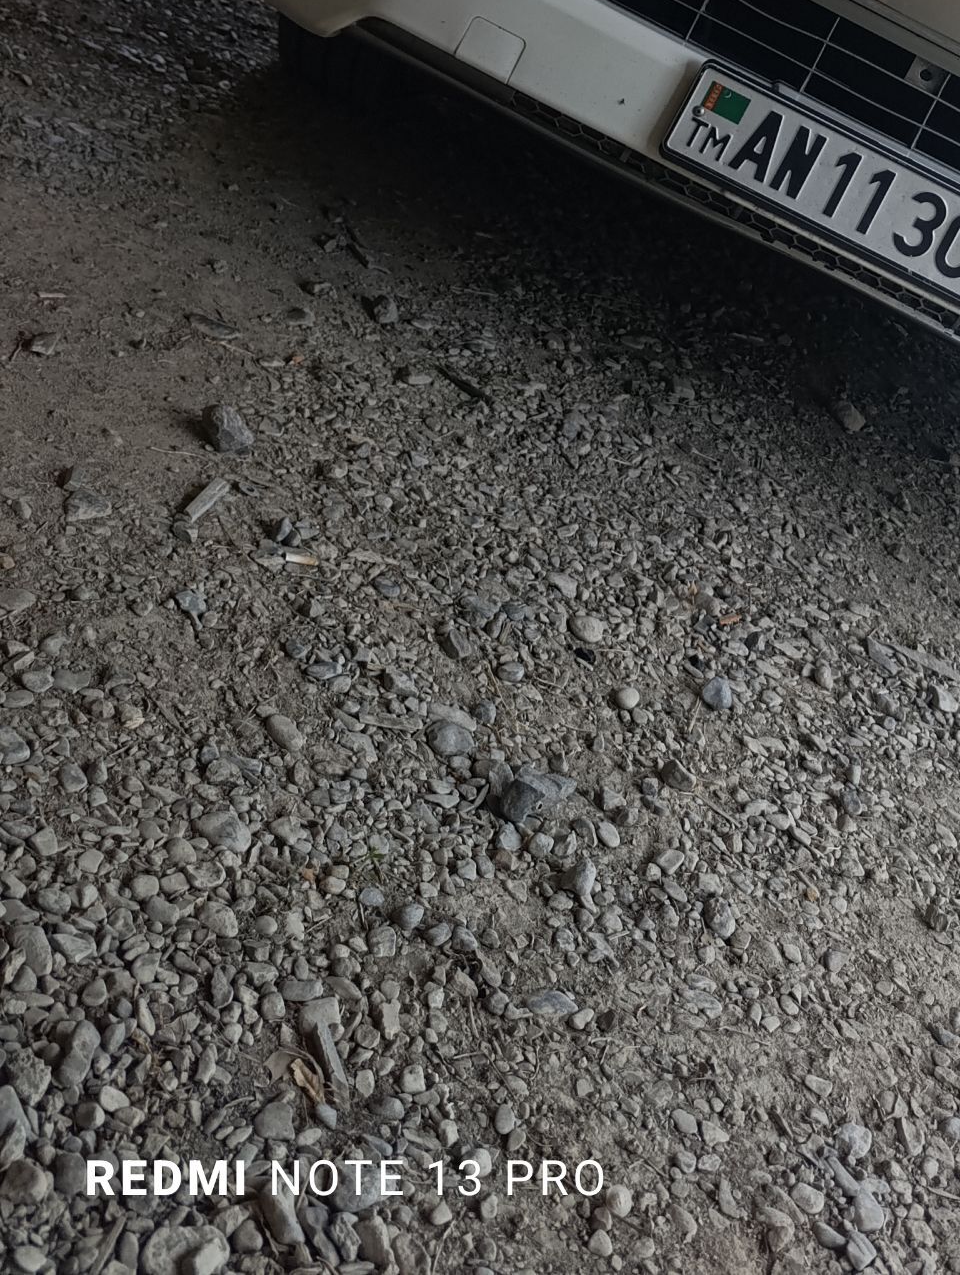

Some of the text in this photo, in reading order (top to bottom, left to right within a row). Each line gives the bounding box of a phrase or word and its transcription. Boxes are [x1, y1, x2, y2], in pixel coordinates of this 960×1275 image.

[685, 116, 731, 162] TM
[727, 110, 827, 201] AN
[821, 152, 897, 236] 11
